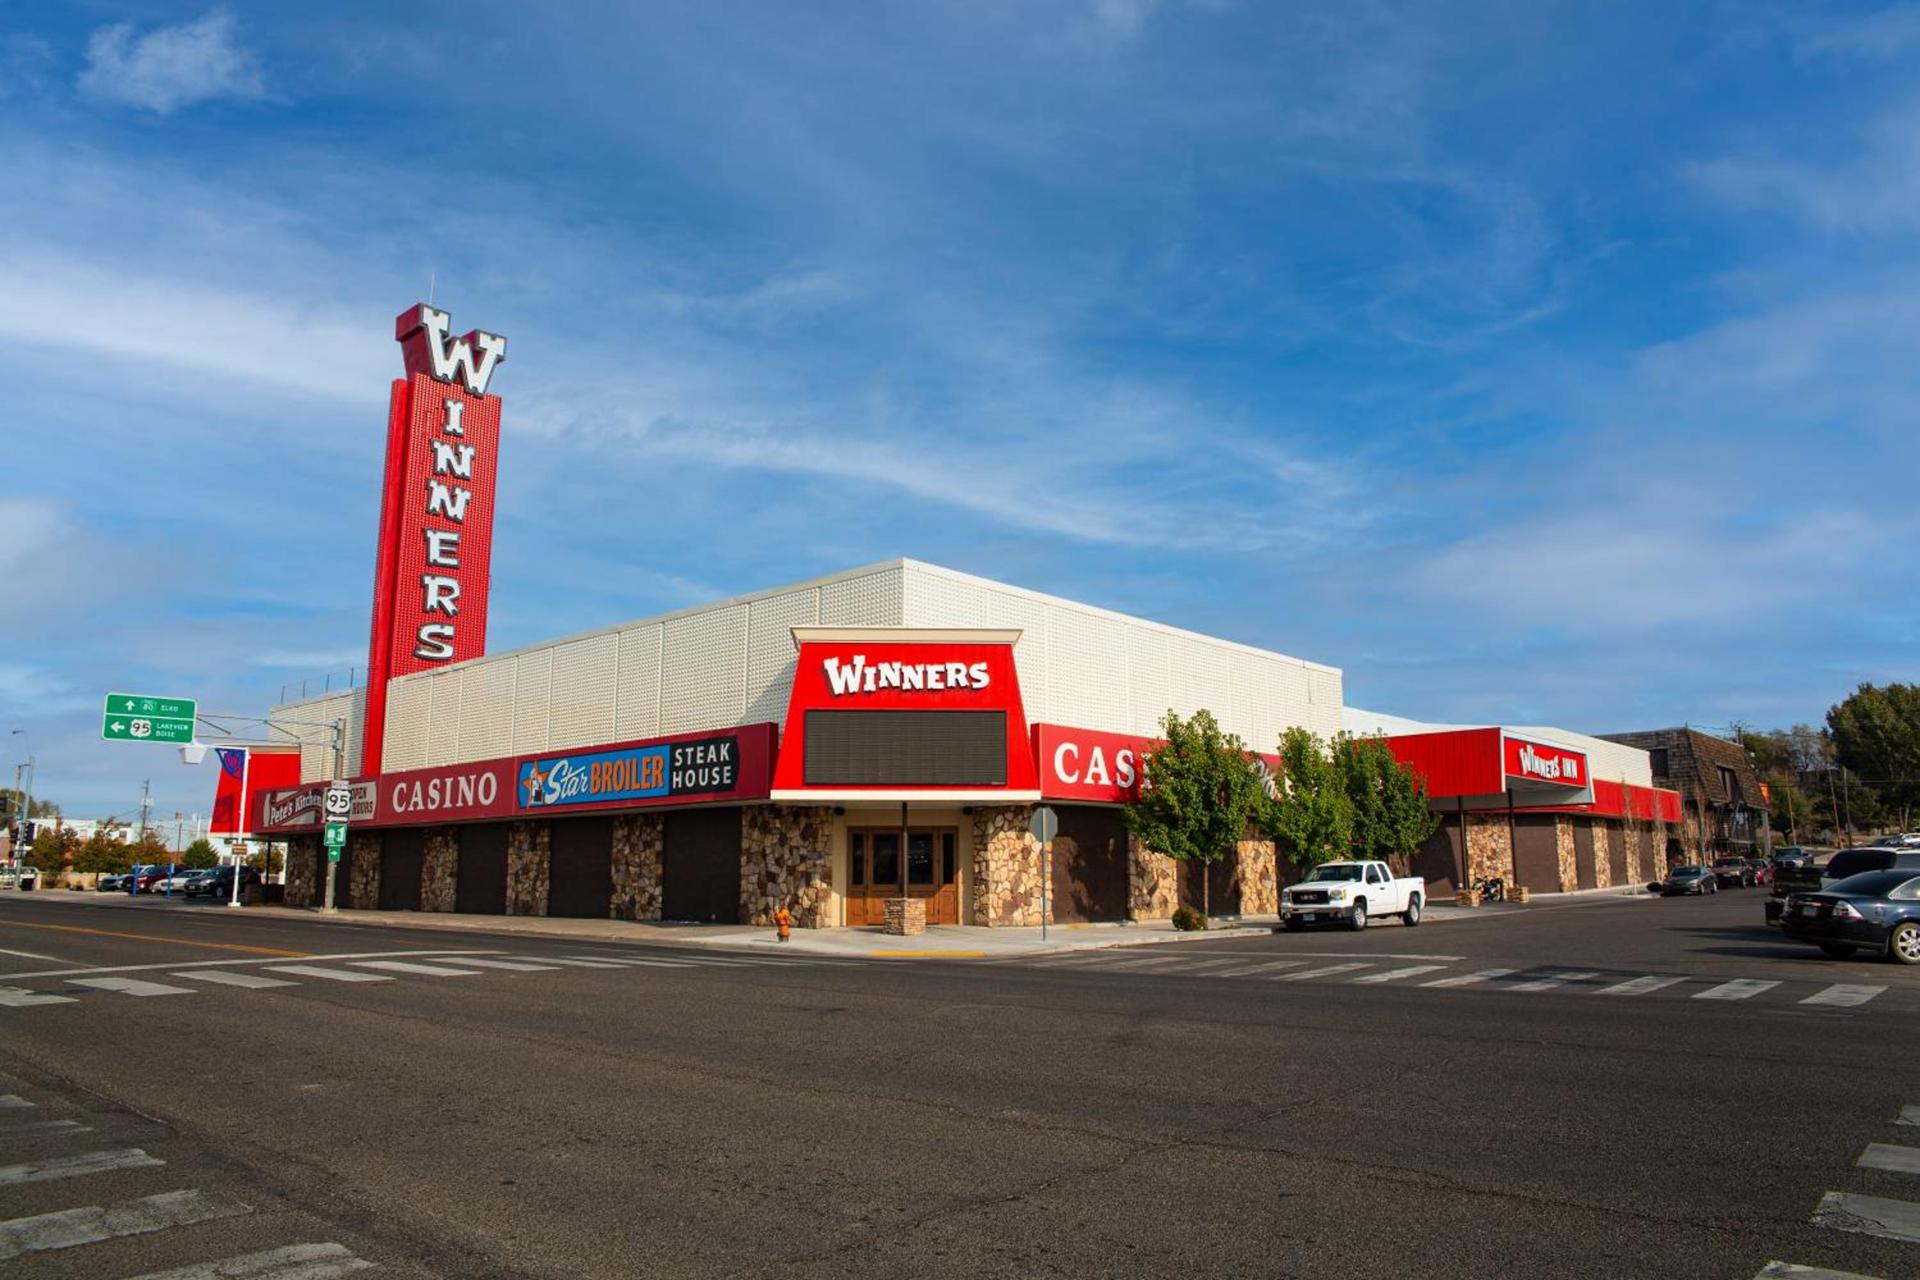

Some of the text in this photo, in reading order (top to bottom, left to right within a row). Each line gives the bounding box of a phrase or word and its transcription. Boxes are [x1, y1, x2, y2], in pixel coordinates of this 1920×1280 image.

[413, 303, 507, 662] WINNERS
[823, 655, 991, 696] WINNERS
[132, 722, 150, 734] 95
[155, 730, 176, 738] BOISE
[156, 723, 189, 731] LAKEVIEW
[674, 743, 731, 767] STEAK
[1054, 742, 1153, 790] CASI
[1519, 744, 1578, 779] WINNERS INN
[544, 755, 664, 804] Star BROILER
[672, 766, 732, 789] HOUSE
[329, 794, 348, 809] 95
[392, 772, 498, 813] CASINO
